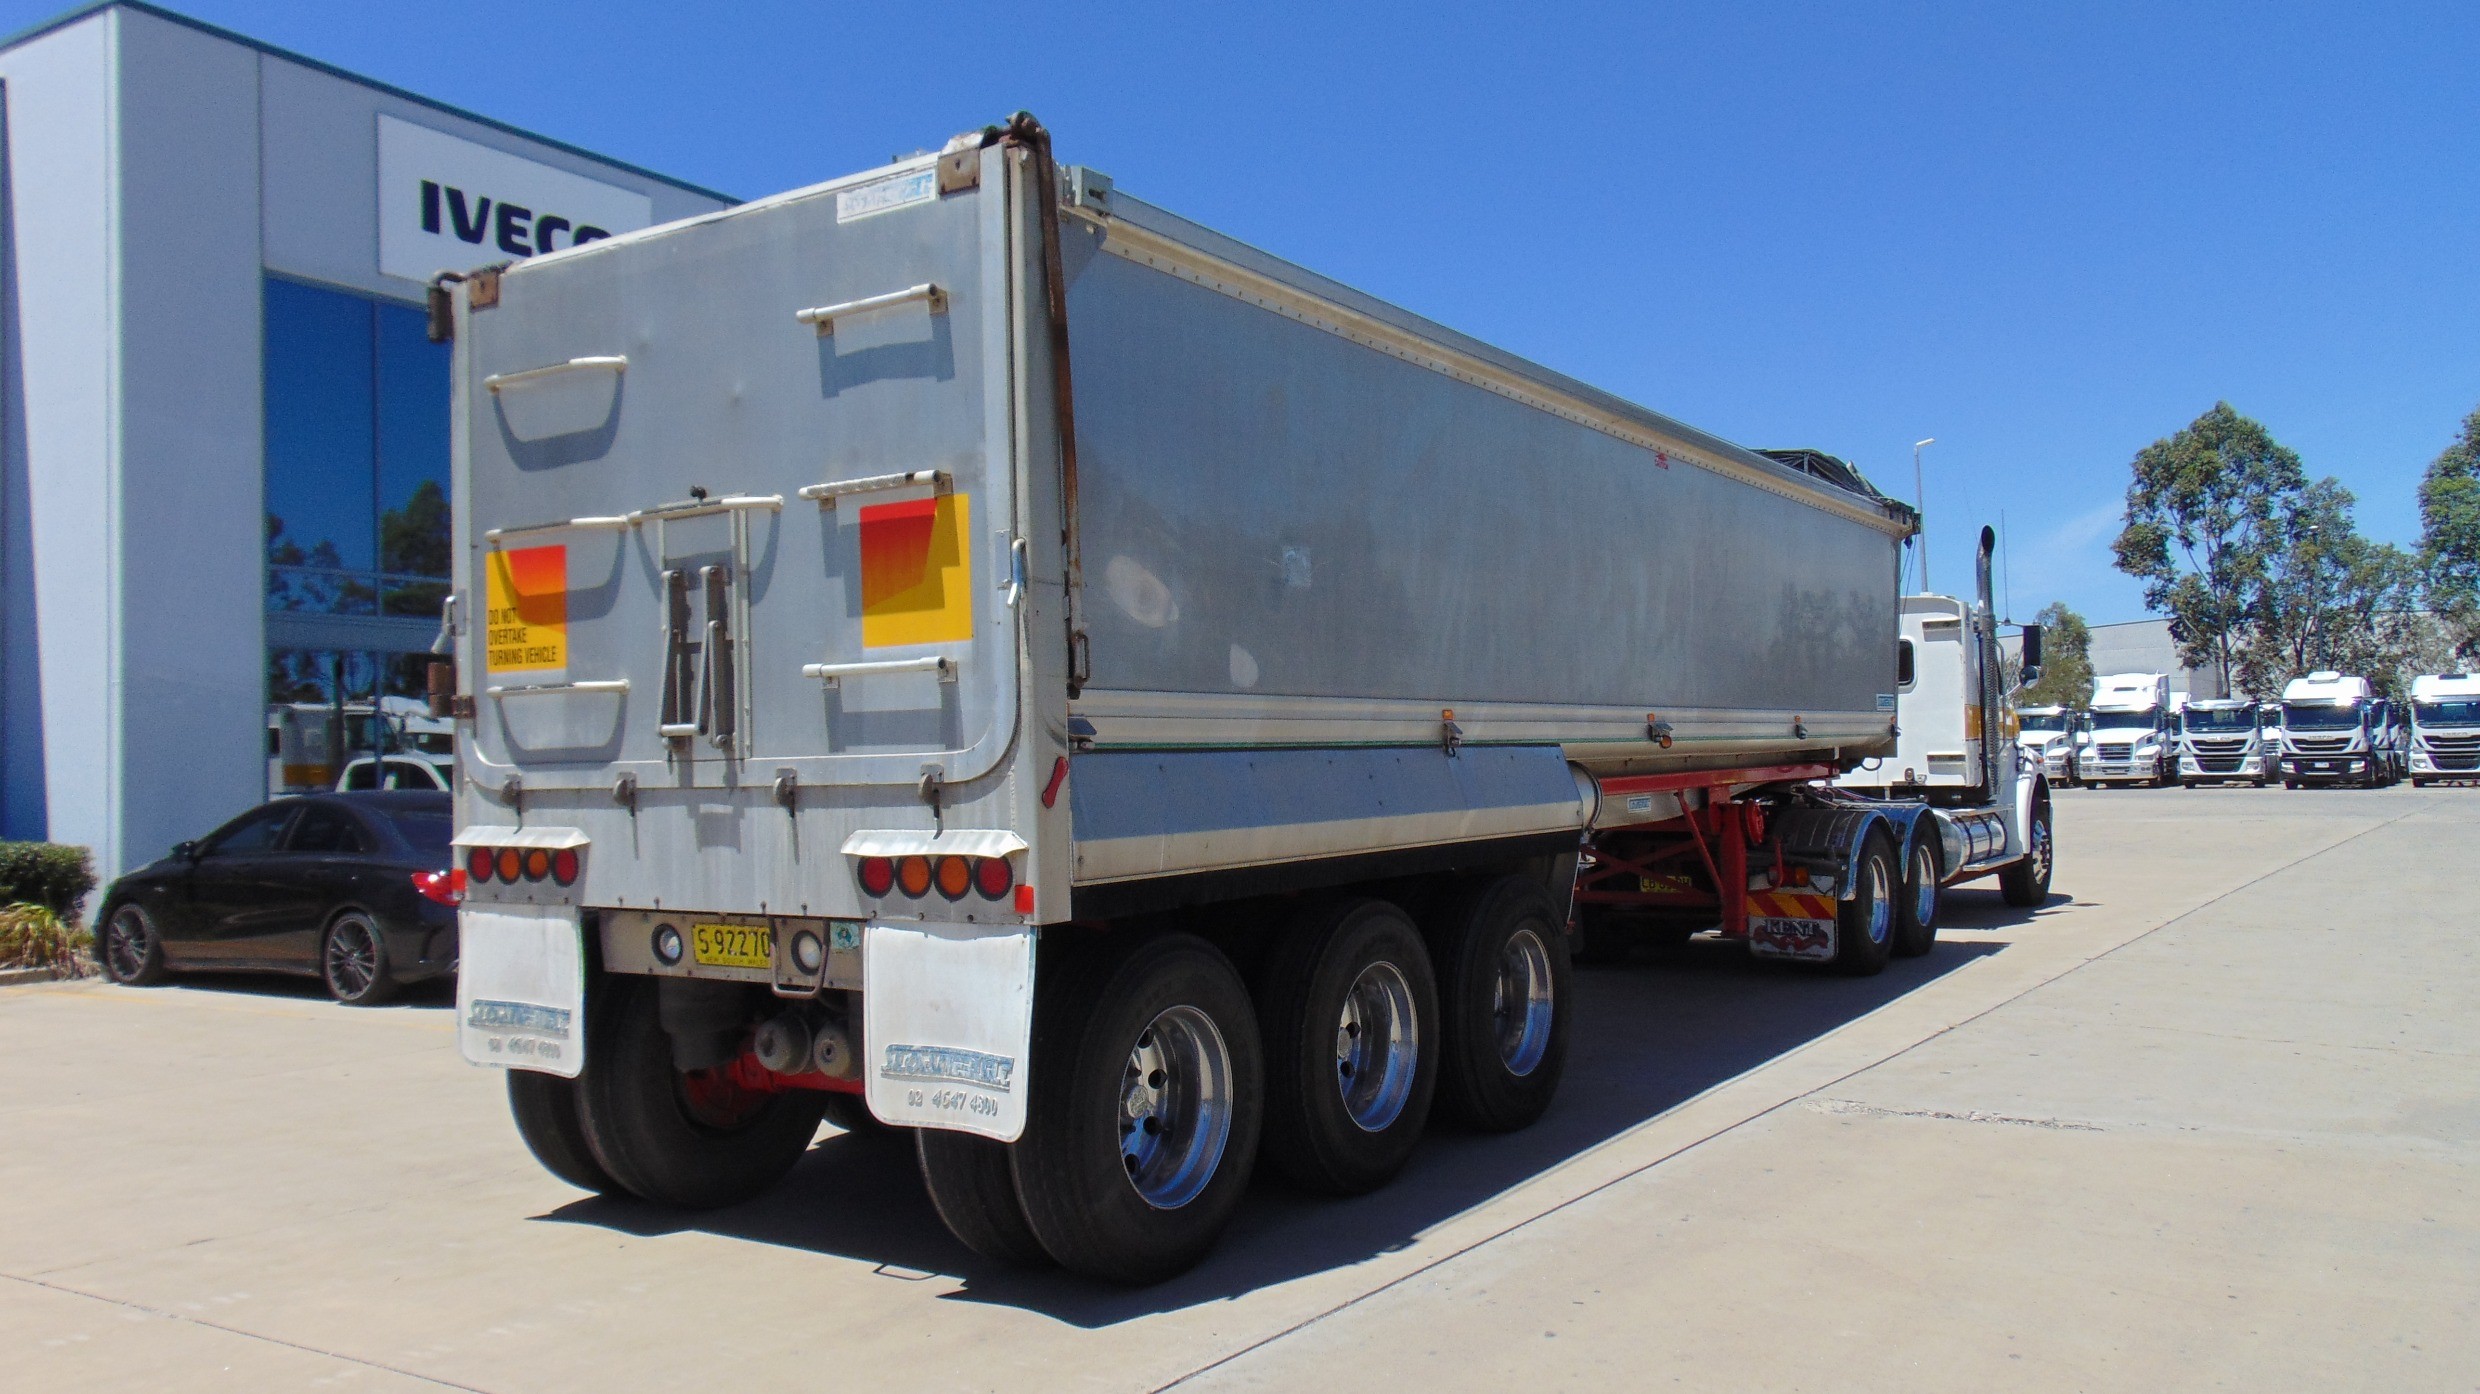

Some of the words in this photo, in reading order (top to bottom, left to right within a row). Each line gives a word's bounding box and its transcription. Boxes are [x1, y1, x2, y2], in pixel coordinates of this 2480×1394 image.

[488, 609, 498, 625] DO
[501, 607, 517, 624] NOT
[488, 627, 527, 645] OVERTAKE
[488, 648, 523, 666] TURNING
[525, 646, 558, 664] VEHICLE
